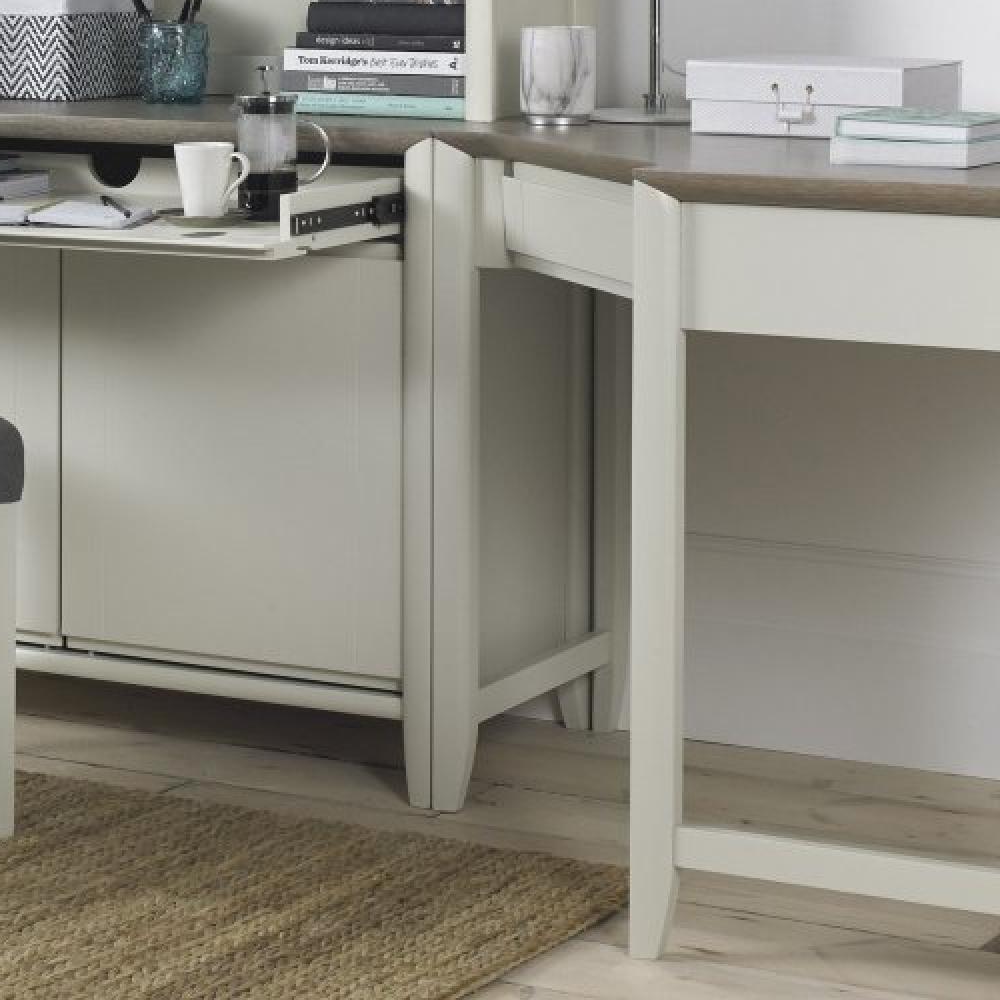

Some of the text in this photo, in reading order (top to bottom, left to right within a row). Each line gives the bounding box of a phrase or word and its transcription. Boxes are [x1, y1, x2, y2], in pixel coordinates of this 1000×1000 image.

[315, 35, 338, 47] design
[340, 35, 360, 45] ideas
[298, 55, 318, 65] Tom
[319, 55, 368, 68] Kerridge's
